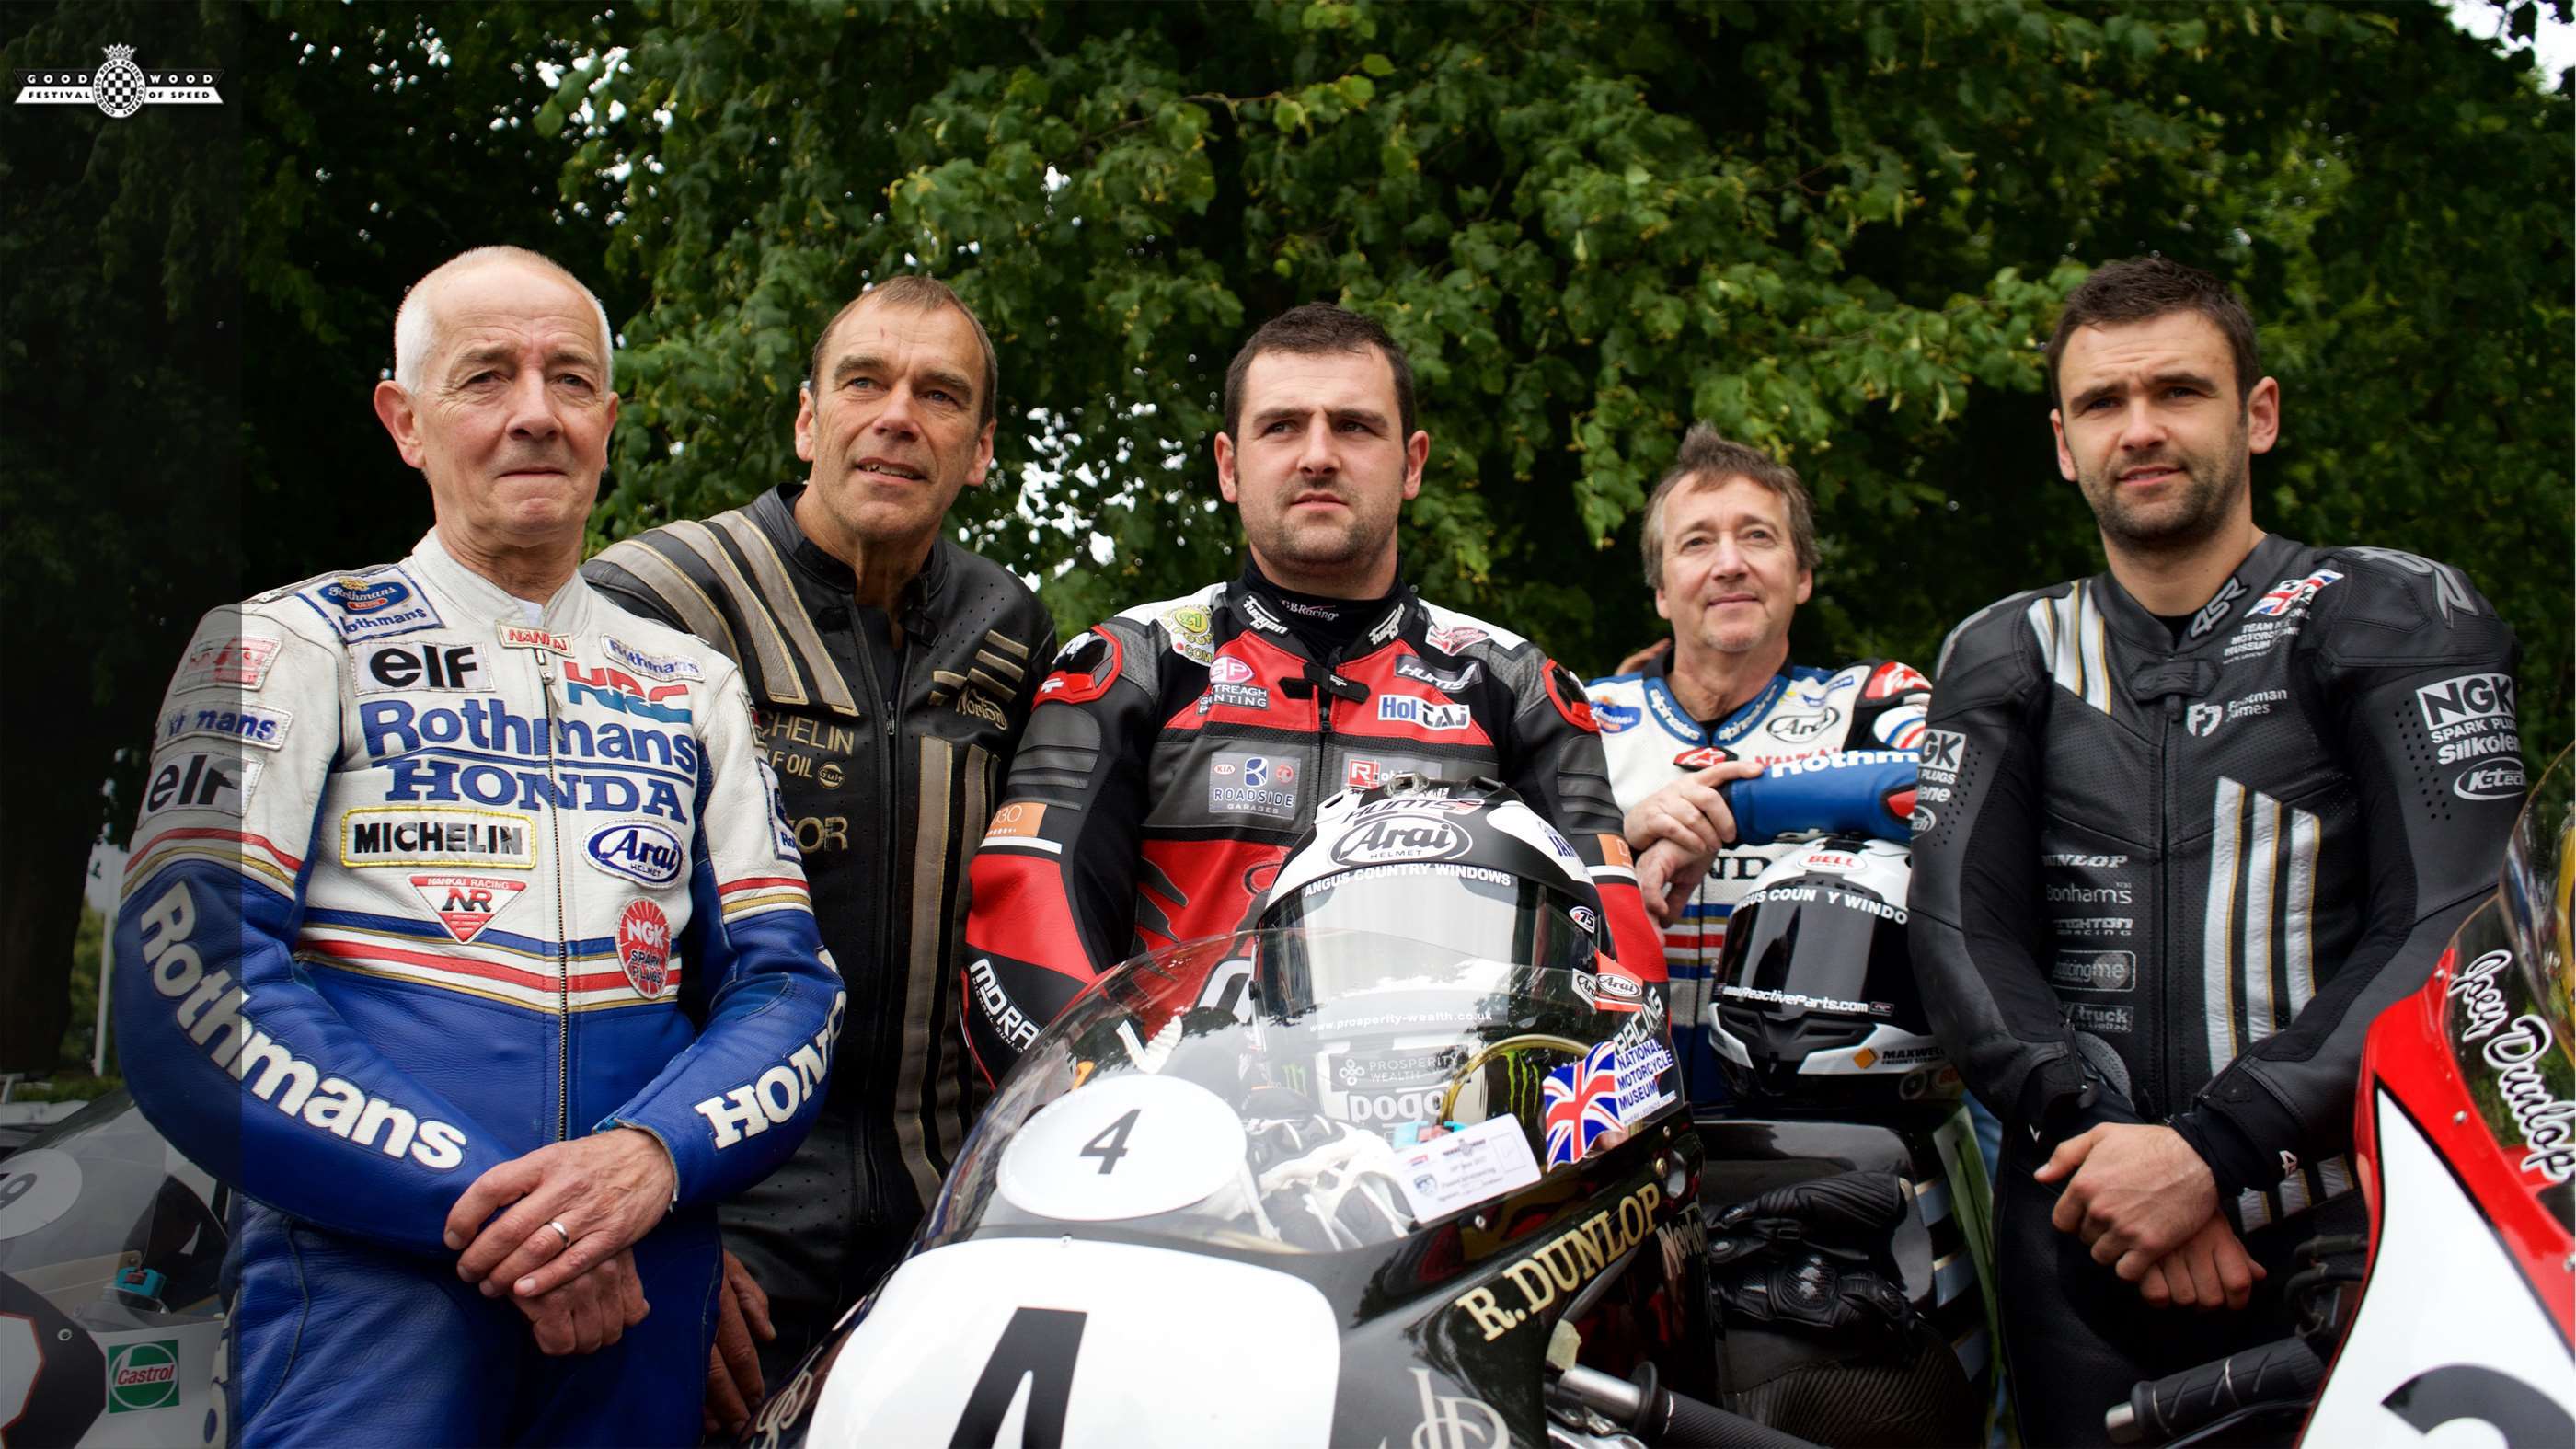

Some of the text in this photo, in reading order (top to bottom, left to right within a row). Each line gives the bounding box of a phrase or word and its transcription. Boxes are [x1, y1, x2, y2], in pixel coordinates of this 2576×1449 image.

[370, 645, 477, 688] elf
[2422, 676, 2514, 727] NGK
[360, 699, 697, 775] Rothmans
[2431, 719, 2488, 743] SPARK
[385, 759, 688, 825] HONDA
[1213, 788, 1295, 808] ROADSIDE
[355, 822, 522, 855] MICHELIN
[598, 829, 679, 871] Arai
[1339, 817, 1451, 860] Arai
[1370, 849, 1421, 860] HELMET
[631, 862, 661, 878] HELMET
[1808, 854, 1853, 867] BELL
[470, 880, 510, 890] RACING
[1305, 863, 1511, 898] ANGUS COUNTRY WINDOWS
[2047, 883, 2133, 904] Bonhams
[627, 918, 664, 949] NGK
[630, 966, 662, 987] PLUGS
[140, 880, 467, 1170] Rothmans
[1369, 1053, 1459, 1071] PROSPERITY
[1616, 1038, 1662, 1072] NATIONAL
[1617, 1050, 1674, 1091] MOTORCYCLE
[1370, 1070, 1420, 1083] WEALTH
[1618, 1079, 1659, 1111] MUSEUM
[1079, 1108, 1142, 1176] 4
[117, 1364, 174, 1386] Castrol
